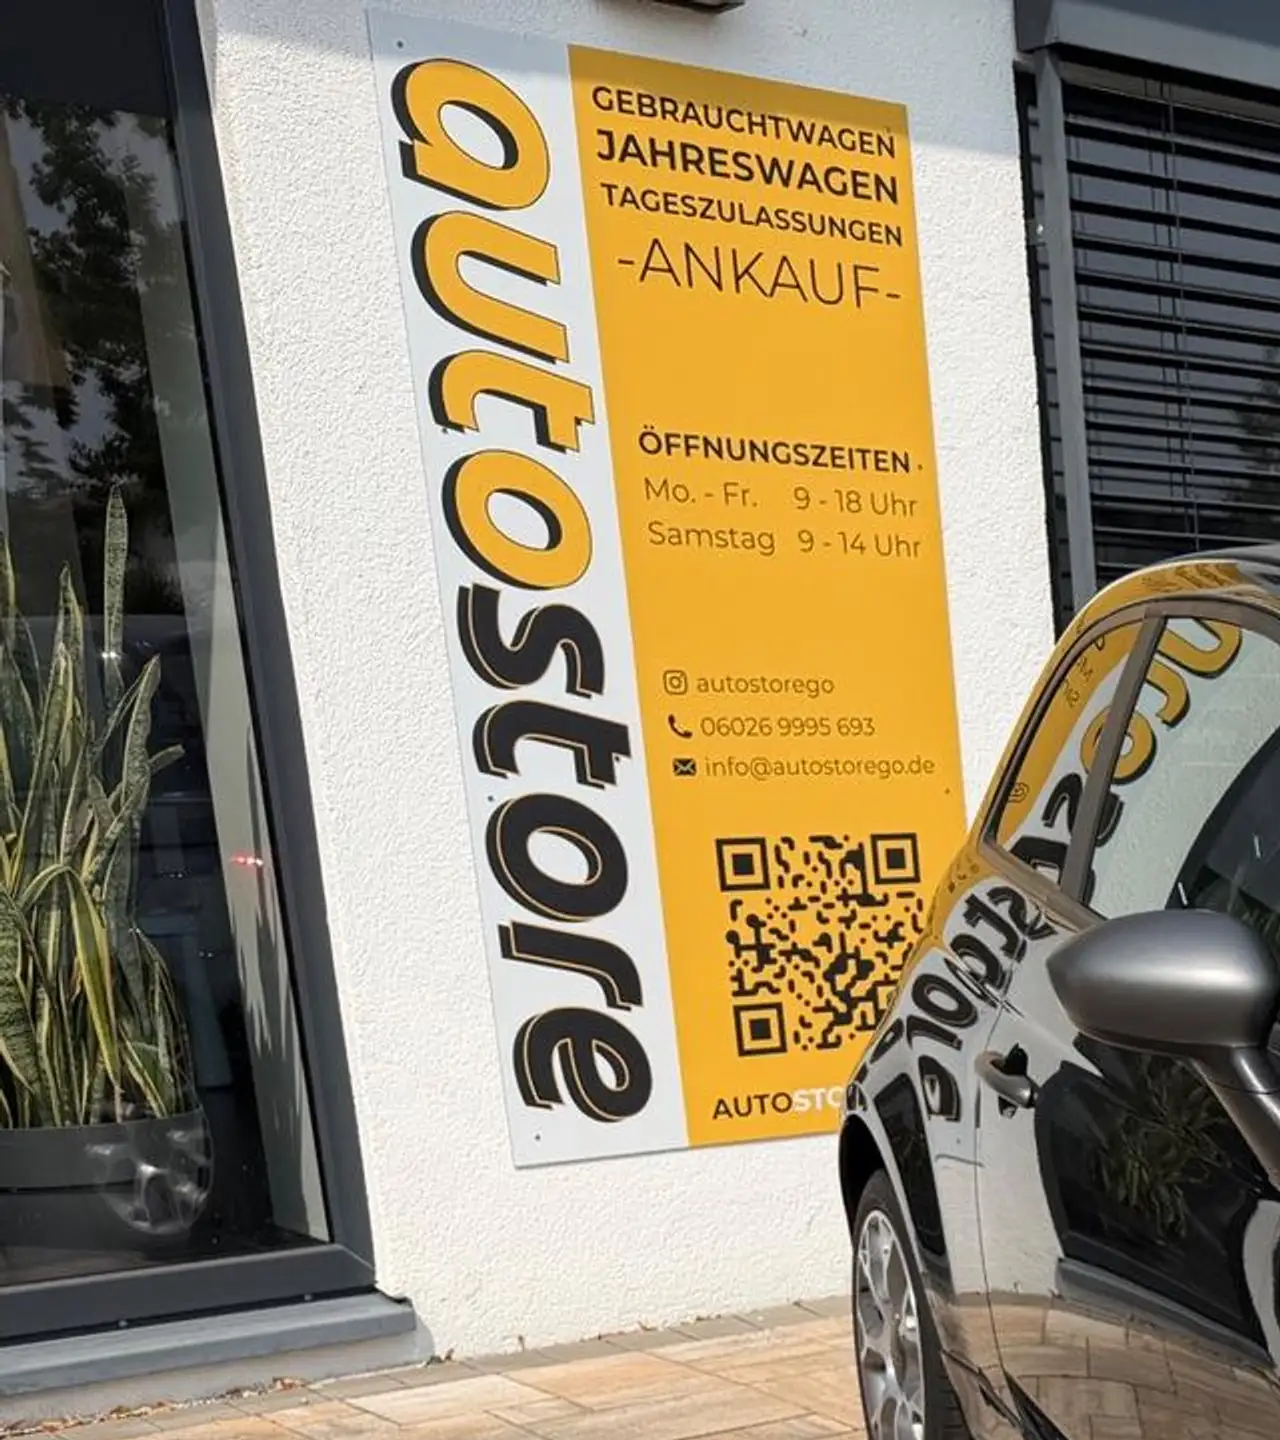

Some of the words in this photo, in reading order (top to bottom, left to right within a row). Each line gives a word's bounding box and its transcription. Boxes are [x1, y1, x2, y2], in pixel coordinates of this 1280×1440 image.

[592, 86, 896, 158] GEBRAUCHTWAGEN
[596, 129, 898, 204] JAHRESWAGEN
[601, 183, 903, 246] TAGESZULASSUNGEN
[618, 238, 901, 308] -ANKAUF-
[639, 425, 910, 473] ÖFFNUNGSZEITEN
[644, 477, 696, 503] Mo.
[723, 481, 758, 507] Fr.
[793, 486, 811, 510] 9
[834, 489, 862, 514] 18
[870, 491, 918, 517] Uhr
[648, 520, 775, 556] Samstag
[797, 529, 815, 553] 9
[838, 531, 866, 556] 14
[874, 534, 921, 558] Uhr
[391, 58, 653, 1124] autostore
[696, 675, 835, 698] autostorego
[700, 717, 773, 738] 06026
[776, 717, 832, 738] 9995
[836, 717, 876, 738] 693
[705, 755, 936, 781] info@autostorego.de
